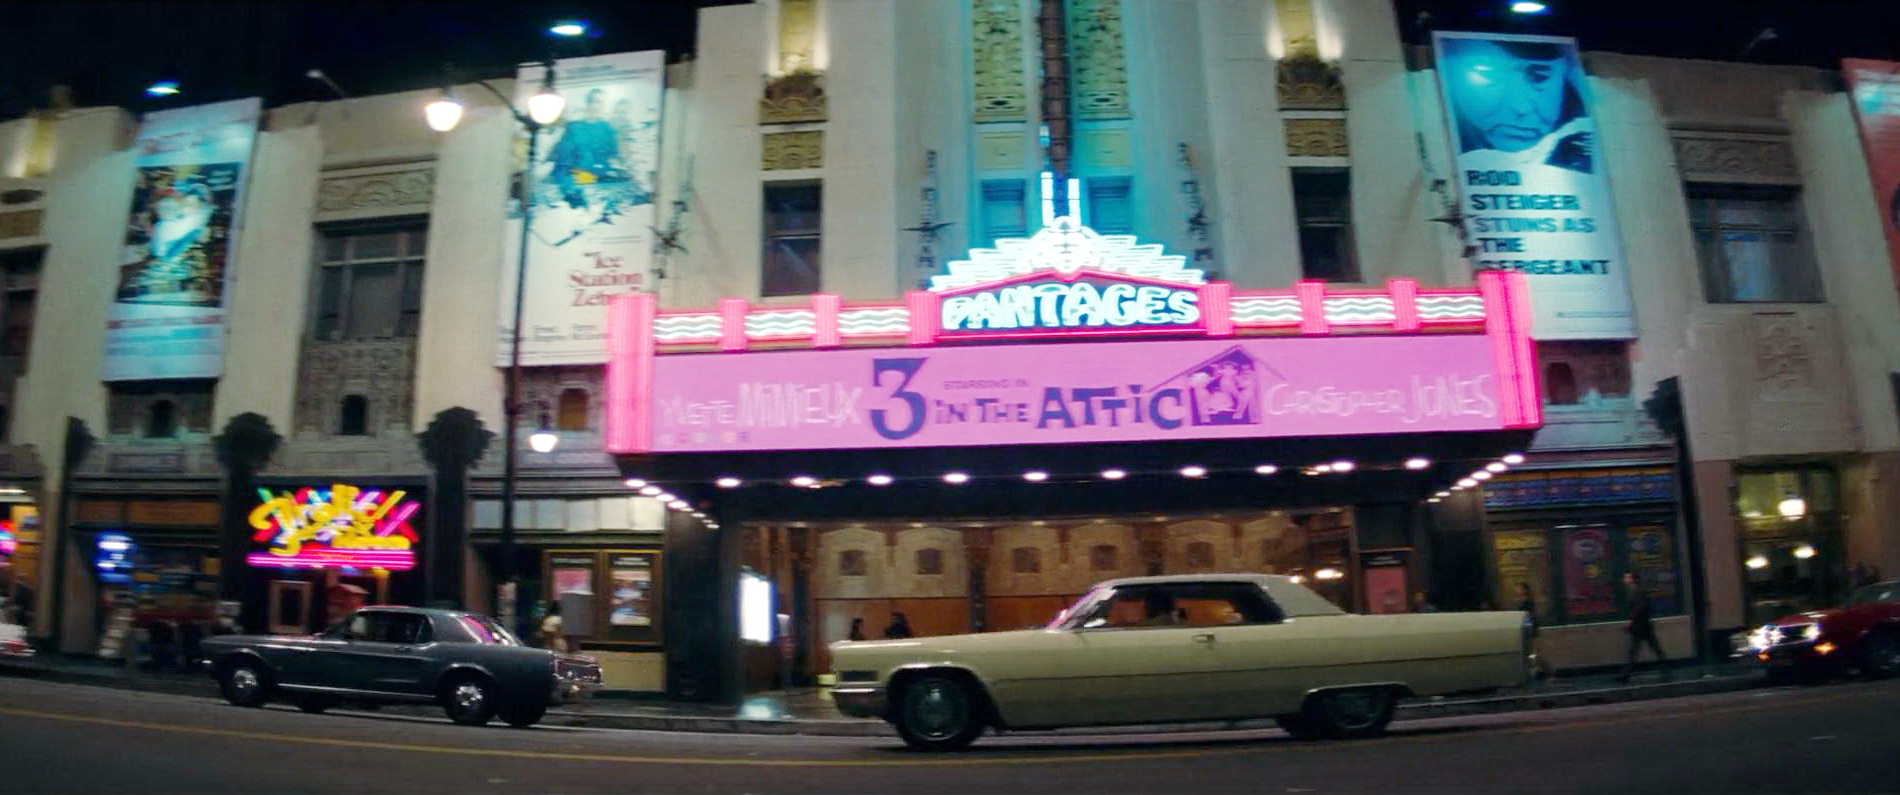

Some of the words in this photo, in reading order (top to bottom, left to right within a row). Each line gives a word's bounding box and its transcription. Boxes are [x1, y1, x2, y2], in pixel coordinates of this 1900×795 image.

[1467, 170, 1521, 186] ROD
[1471, 194, 1580, 210] STEIGER
[1475, 217, 1556, 232] STUNS
[1564, 218, 1597, 232] AS
[1477, 238, 1523, 252] THE
[942, 283, 1200, 329] PANTAGES
[870, 357, 928, 440] 3
[974, 398, 1029, 423] THE
